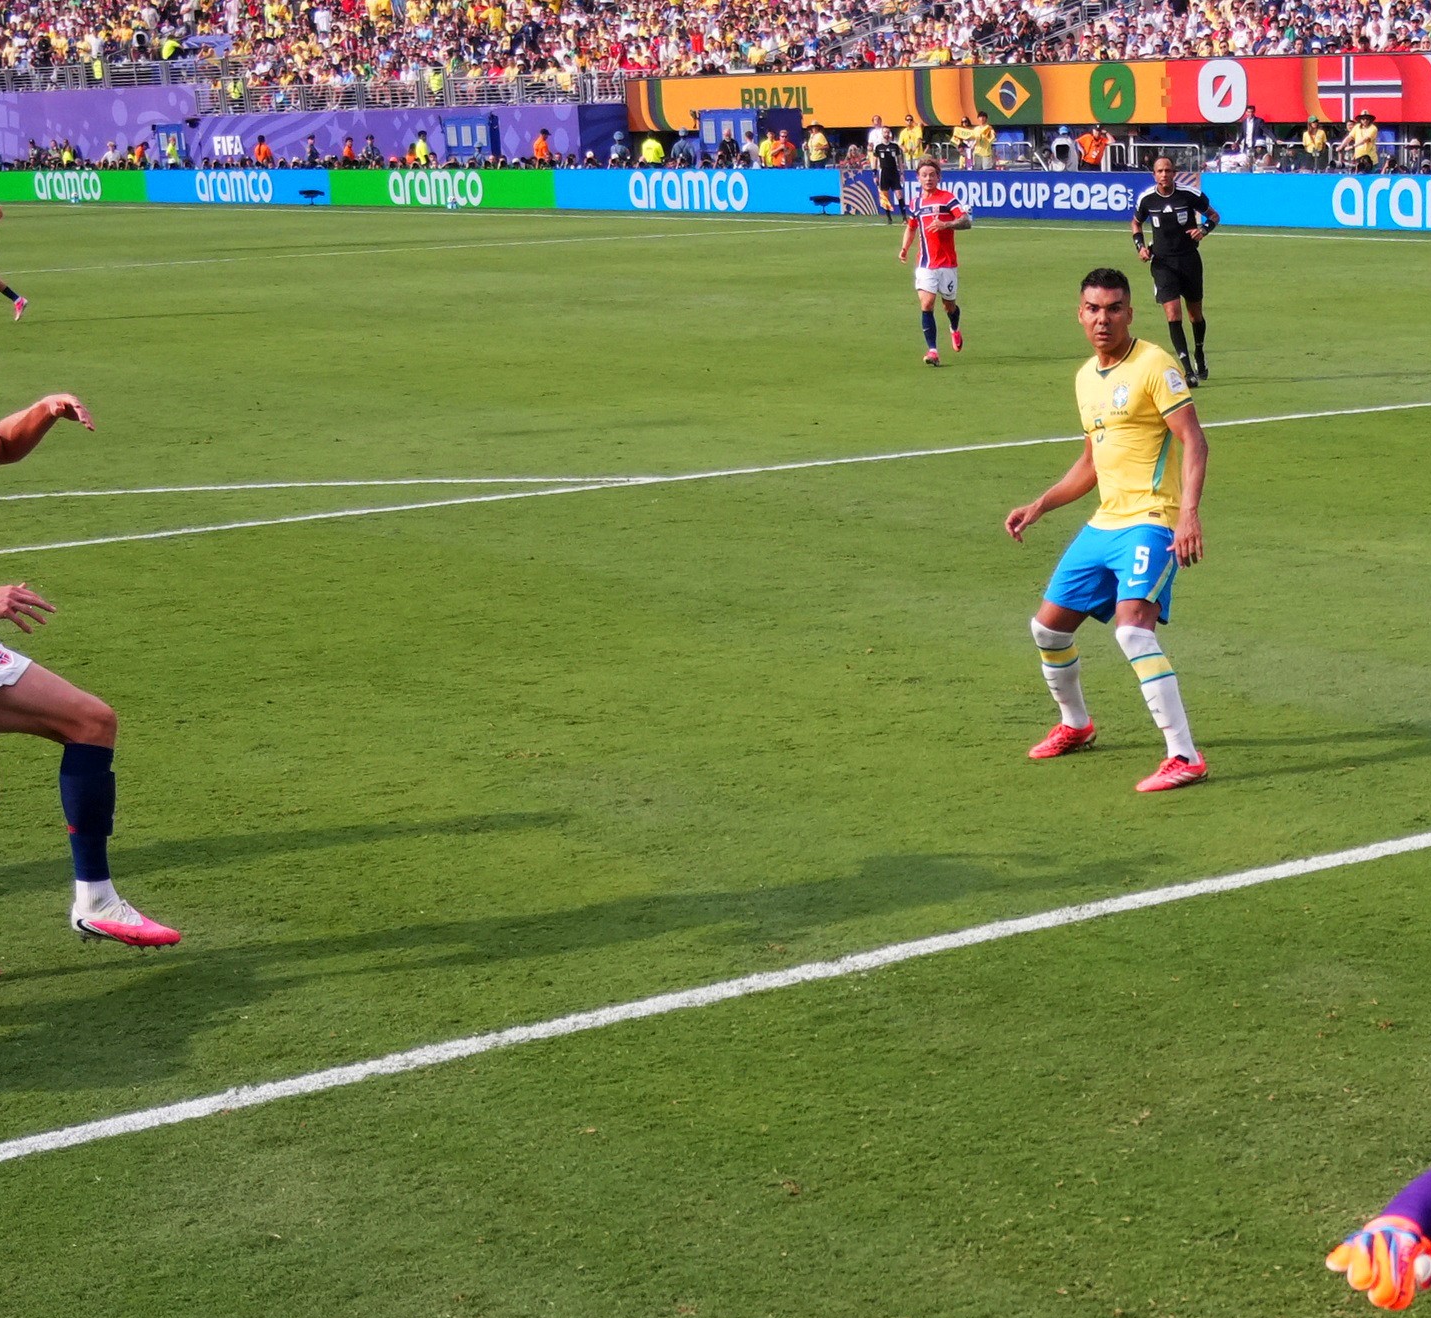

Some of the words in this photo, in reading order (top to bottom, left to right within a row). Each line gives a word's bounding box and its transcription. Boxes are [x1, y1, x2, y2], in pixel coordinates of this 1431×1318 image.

[741, 87, 813, 115] BRAZIL
[213, 135, 244, 156] FIFA
[34, 171, 102, 201] aramco
[196, 171, 273, 203] aramco
[388, 171, 483, 207] aramco
[629, 171, 749, 211] aramco
[1011, 182, 1050, 209] CUP
[1053, 183, 1126, 211] 2026
[1133, 546, 1150, 574] 5
